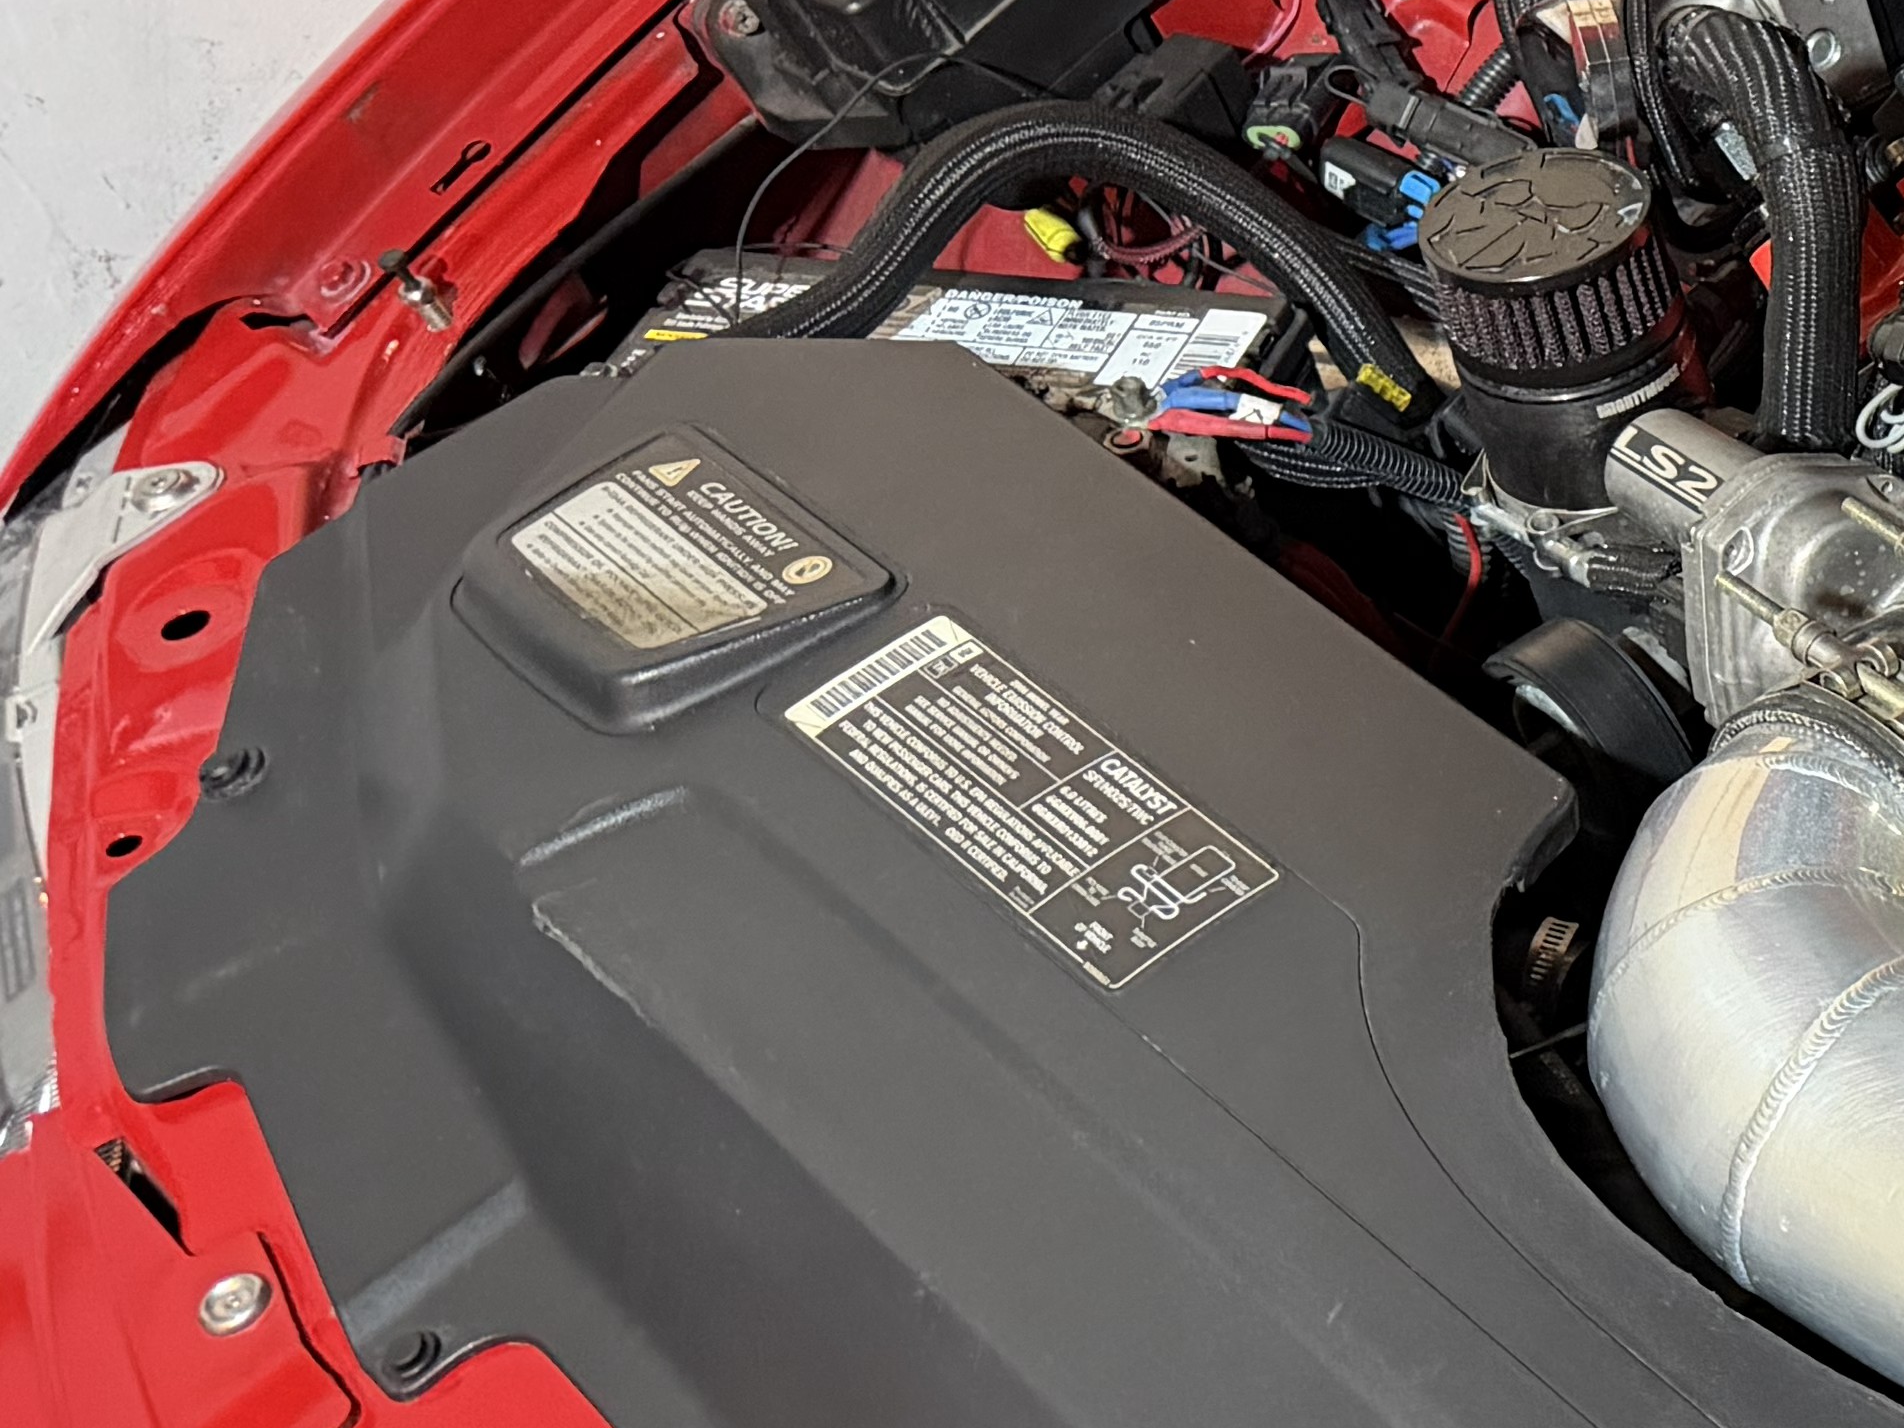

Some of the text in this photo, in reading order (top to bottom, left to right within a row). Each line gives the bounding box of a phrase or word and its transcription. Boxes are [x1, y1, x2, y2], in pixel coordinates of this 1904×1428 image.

[945, 289, 1083, 309] DANGER/POISON
[614, 471, 661, 507] CONTINUE
[1611, 425, 1718, 504] LS2
[654, 488, 687, 511] START
[696, 479, 802, 552] CAUTION!
[967, 663, 1087, 755] VEHICLE EMISSION CONTROL
[983, 691, 1045, 739] INFORMATION
[836, 719, 874, 748] FEDERAL
[921, 788, 964, 822] CERTIFIED
[956, 817, 980, 835] FOR
[971, 830, 998, 850] SALE
[847, 747, 870, 765] AND
[862, 760, 905, 793] QUALIFIES
[861, 700, 884, 718] THIS
[876, 712, 912, 740] VEHICLE
[903, 734, 950, 771] CONFORMS
[982, 797, 1037, 841] REGULATIONS
[1029, 836, 1080, 877] APPLICABLE
[869, 726, 894, 745] NEW
[886, 740, 935, 778] PASSENGER
[948, 790, 971, 808] THIS
[964, 803, 1001, 832] VEHICLE
[993, 827, 1042, 866] CONFORMS
[1097, 755, 1178, 817] CATALYST
